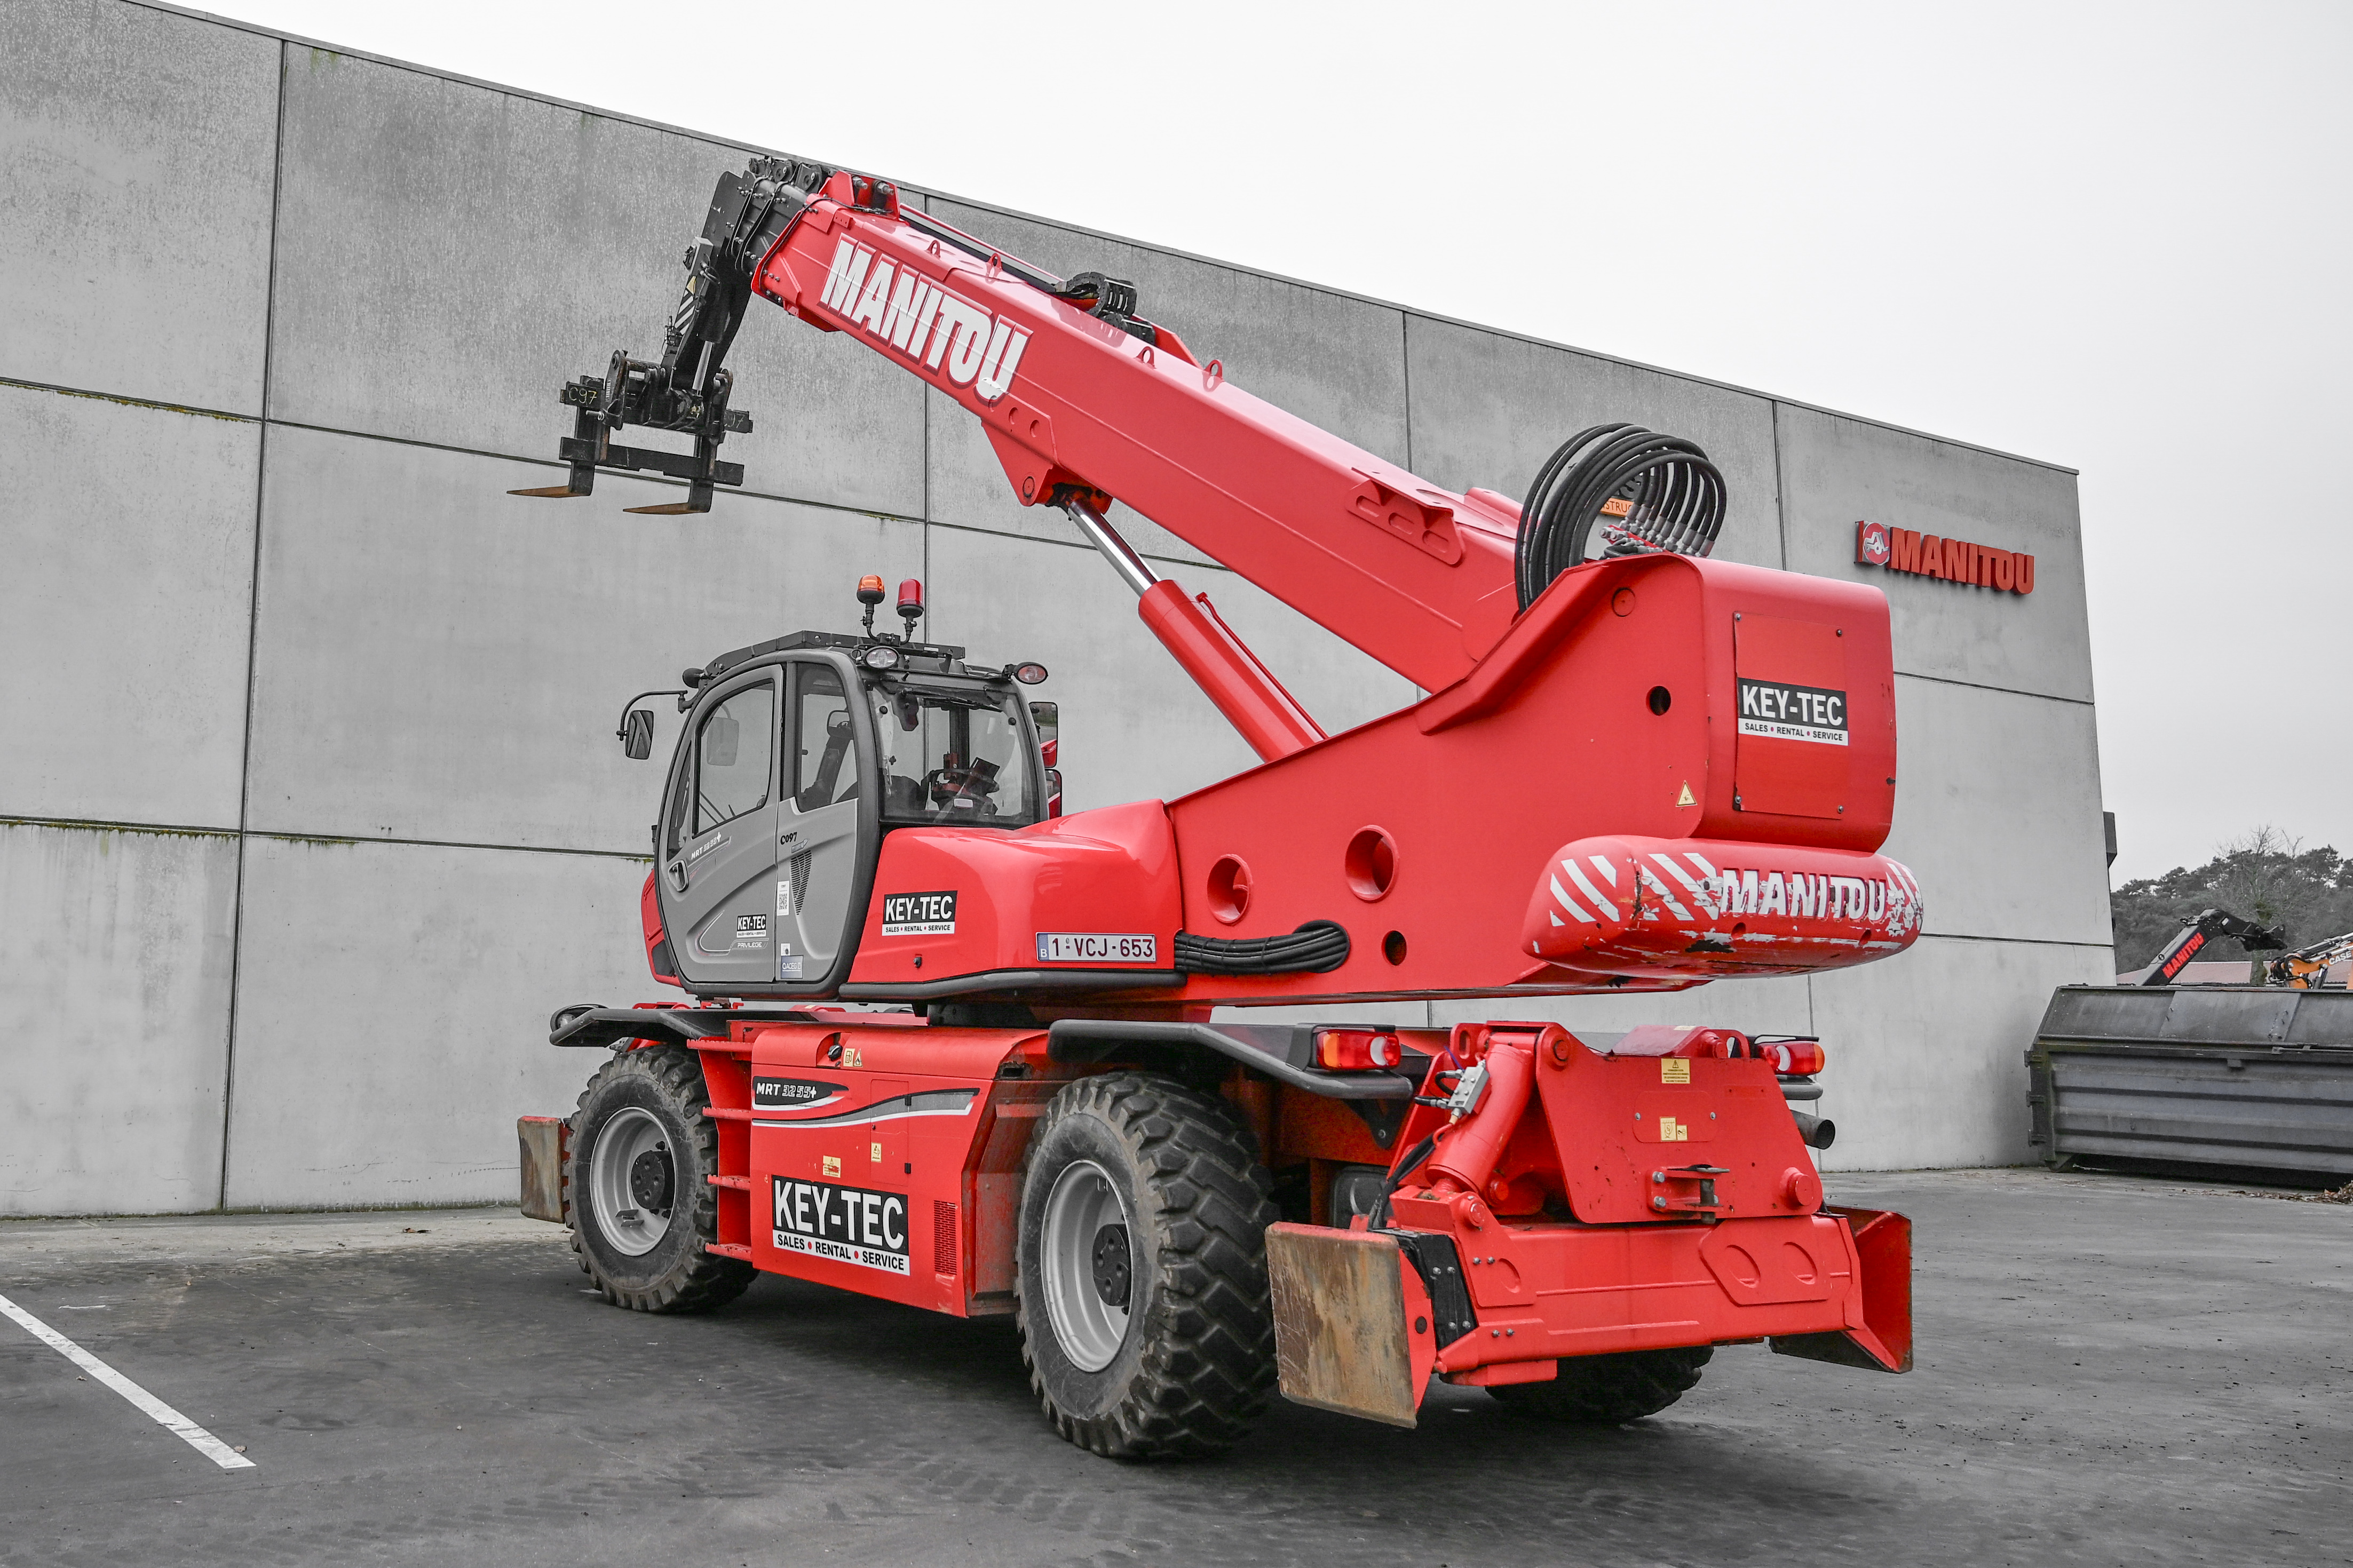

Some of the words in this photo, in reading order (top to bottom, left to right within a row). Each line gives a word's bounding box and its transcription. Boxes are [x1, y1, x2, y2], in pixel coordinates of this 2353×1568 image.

[818, 235, 1032, 404] MANITOU
[569, 387, 597, 405] C97
[1888, 527, 2034, 594] MANITOU
[1742, 684, 1843, 726] KEY-TEC
[1745, 722, 1768, 733] SALES
[1777, 726, 1804, 737] RENTAL
[1813, 730, 1843, 741] SERVICE
[780, 832, 797, 845] C097
[885, 895, 953, 921] KEY-TEC
[1720, 869, 1887, 923] MANITOU
[738, 915, 766, 930] KEY-TEC
[1040, 949, 1048, 958] B
[2162, 932, 2205, 978] MANITOU
[2328, 950, 2352, 965] CASE
[756, 1082, 781, 1096] MRT
[781, 1084, 817, 1099] 3255+
[774, 1180, 905, 1249] KEY-TEC
[778, 1234, 805, 1250] SALES
[815, 1241, 851, 1260] RENTAL
[862, 1251, 904, 1271] SERVICE
